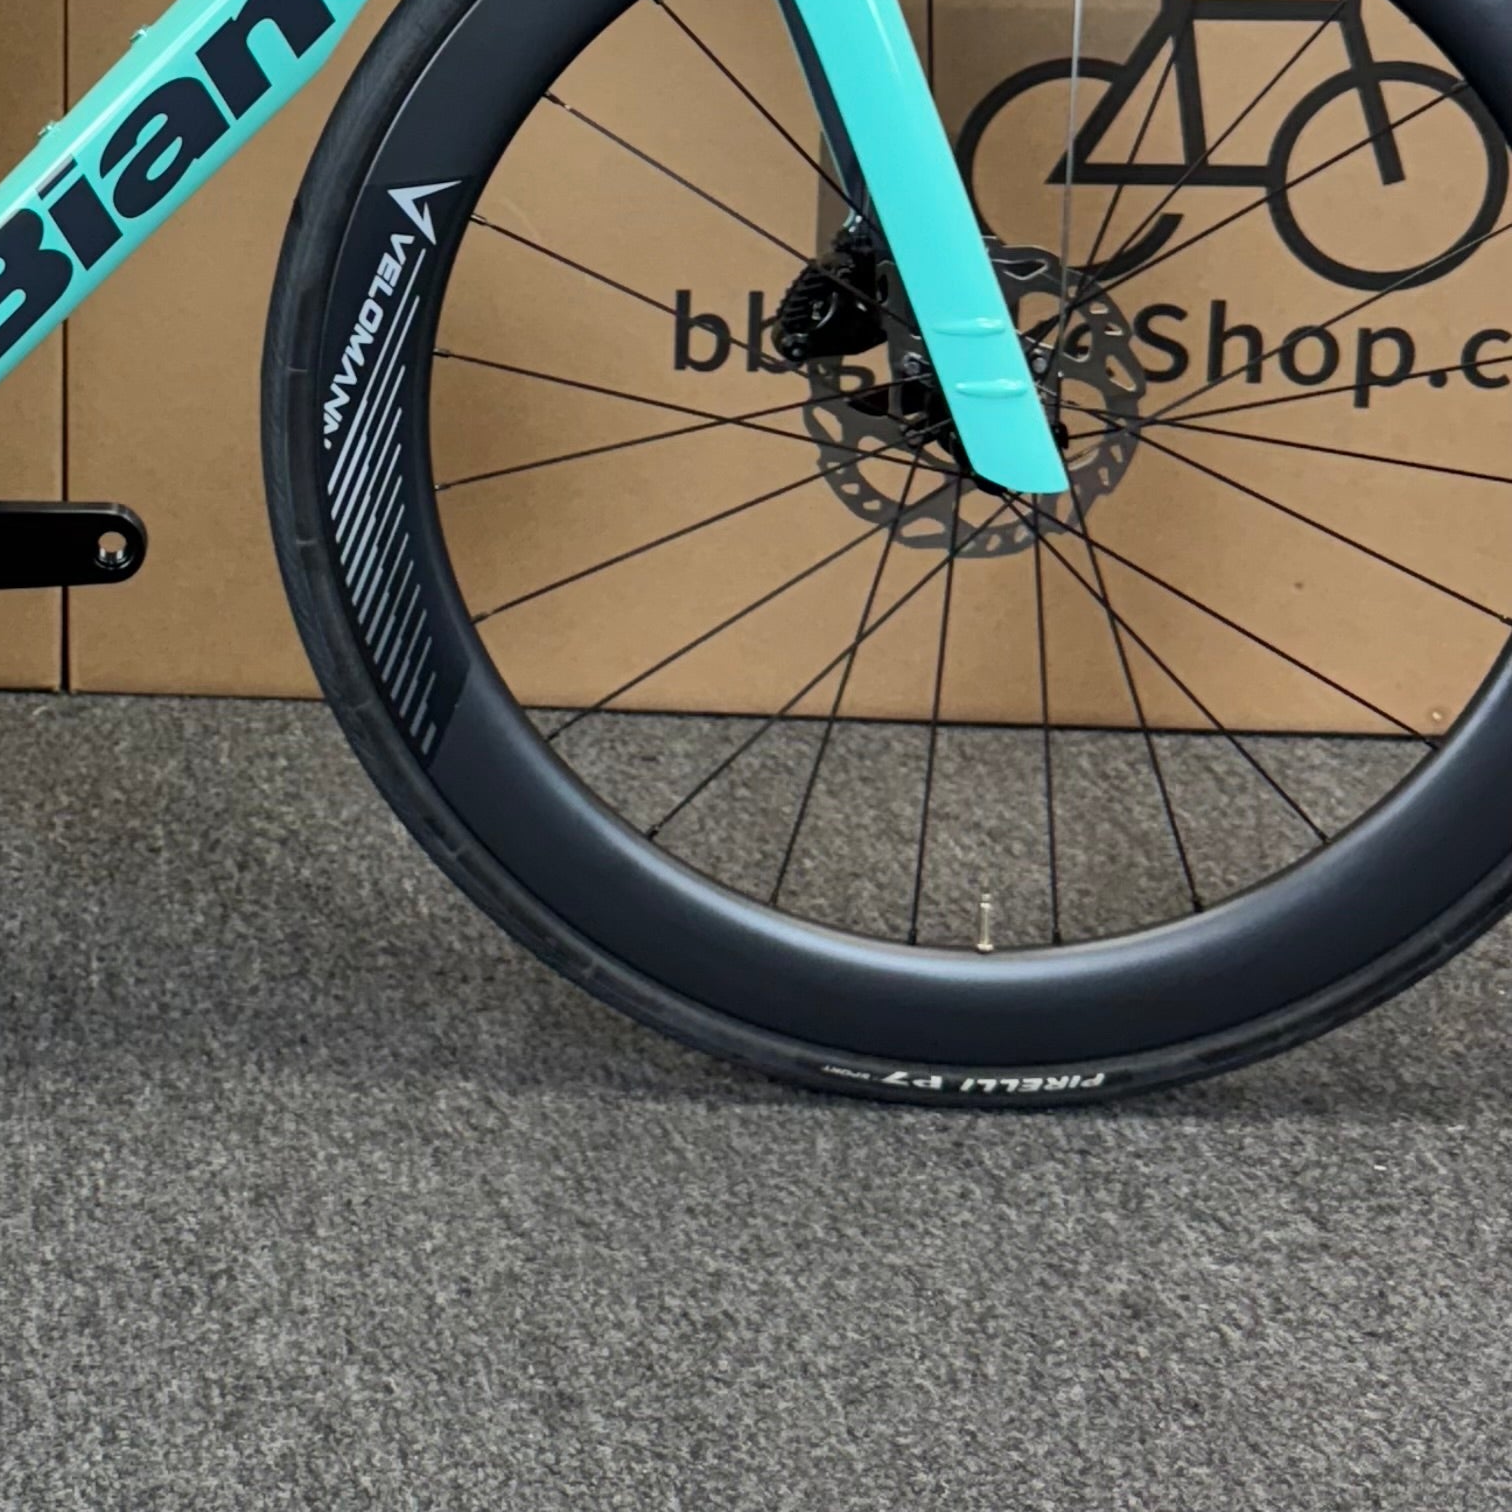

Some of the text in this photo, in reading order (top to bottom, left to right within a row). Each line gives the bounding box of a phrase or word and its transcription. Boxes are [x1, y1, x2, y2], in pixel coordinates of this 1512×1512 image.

[323, 233, 416, 438] VELOMANN
[881, 1070, 943, 1090] P7
[960, 1071, 1106, 1093] PIRELLI
